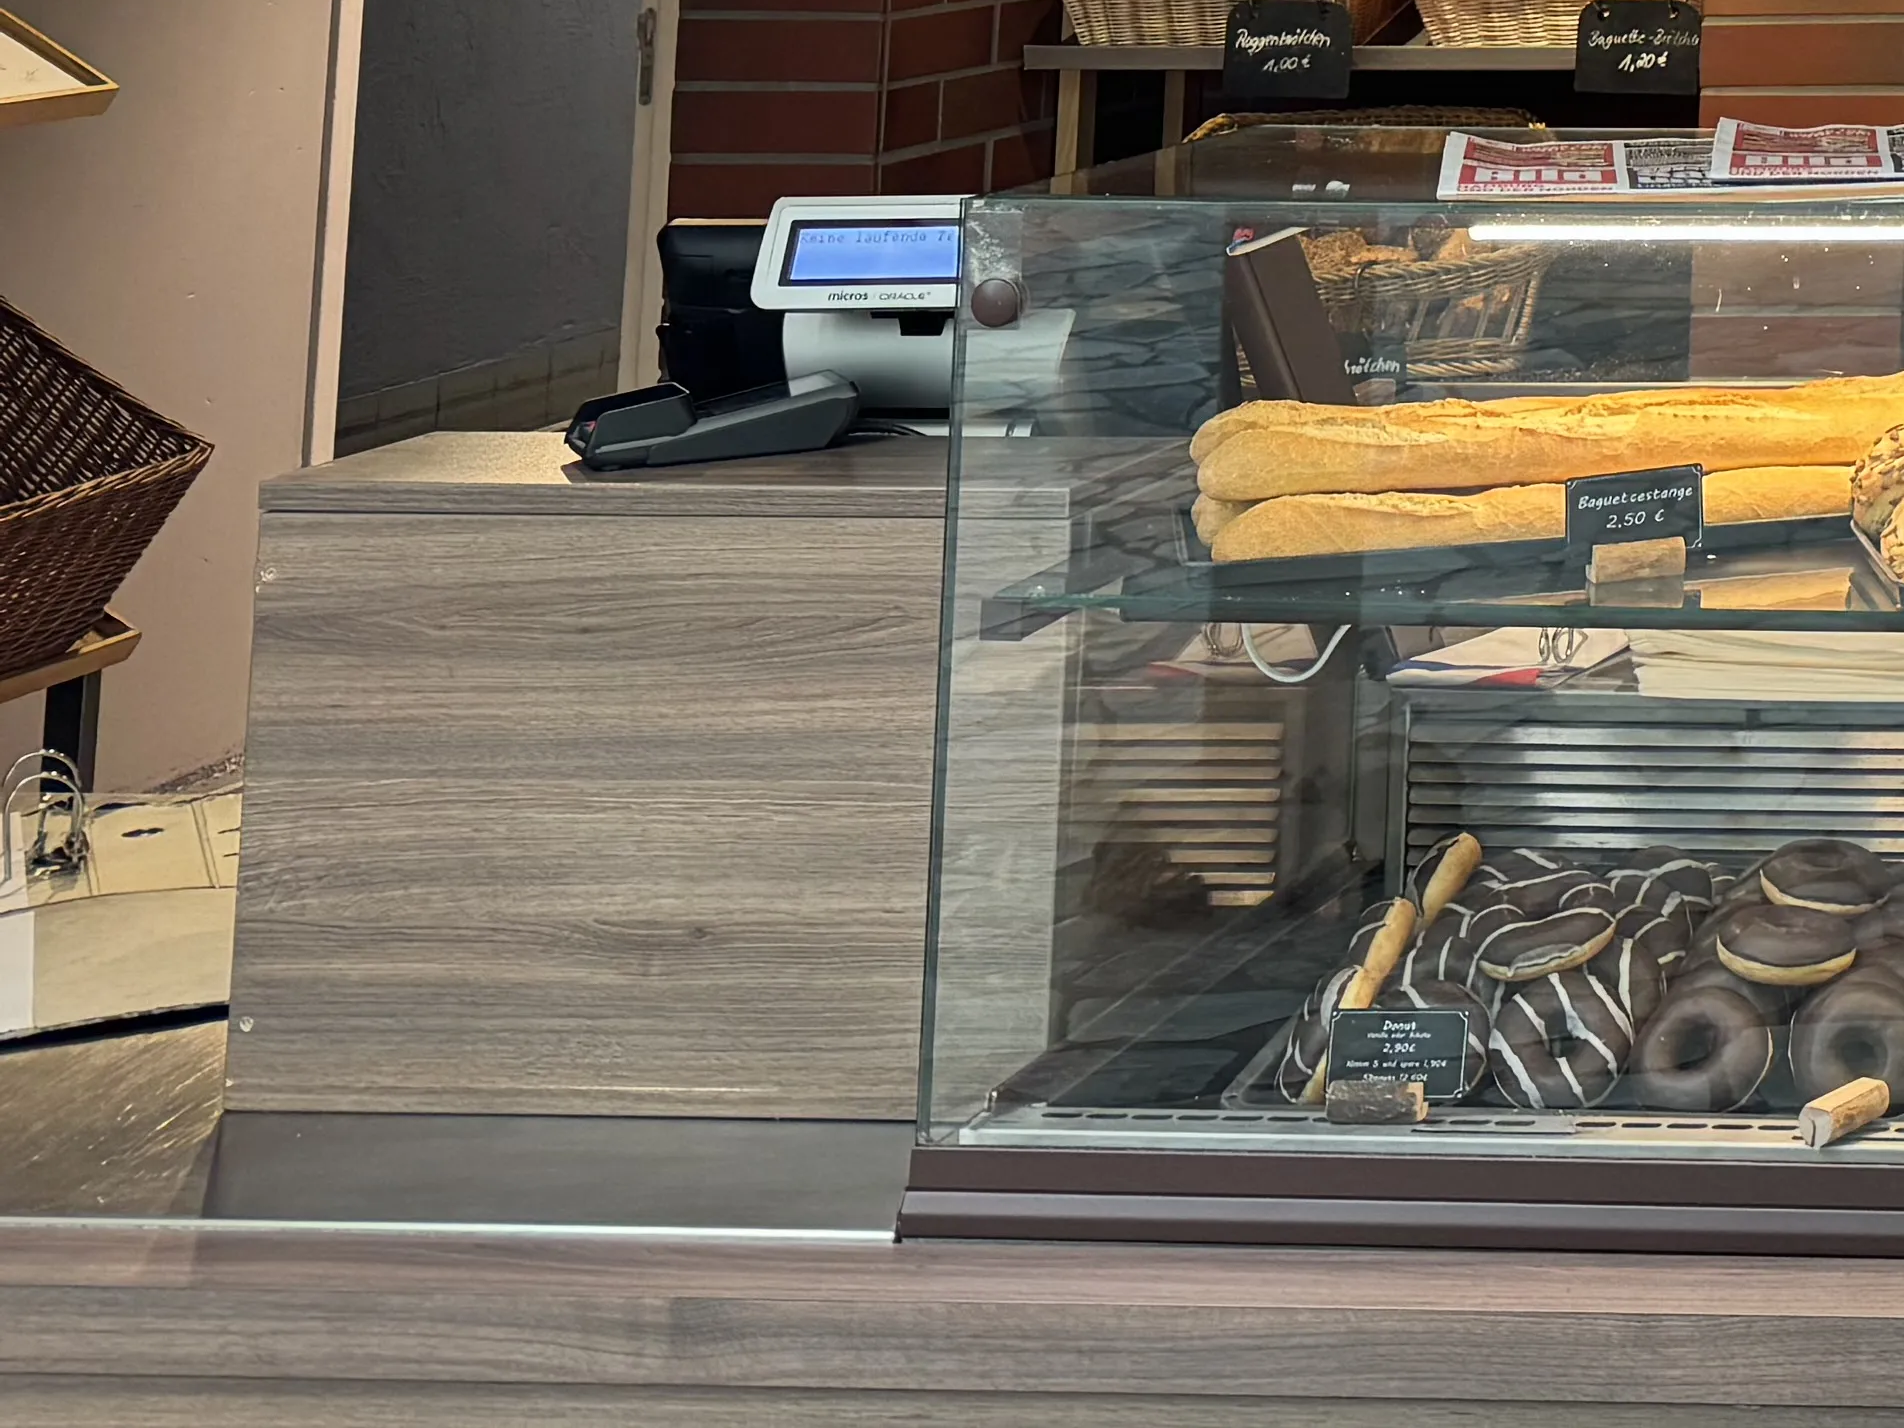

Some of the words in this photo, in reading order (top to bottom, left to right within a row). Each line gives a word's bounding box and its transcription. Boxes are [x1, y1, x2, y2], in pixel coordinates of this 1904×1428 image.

[800, 231, 845, 244] Keine
[828, 290, 868, 301] micros
[1383, 1020, 1416, 1030] Donut
